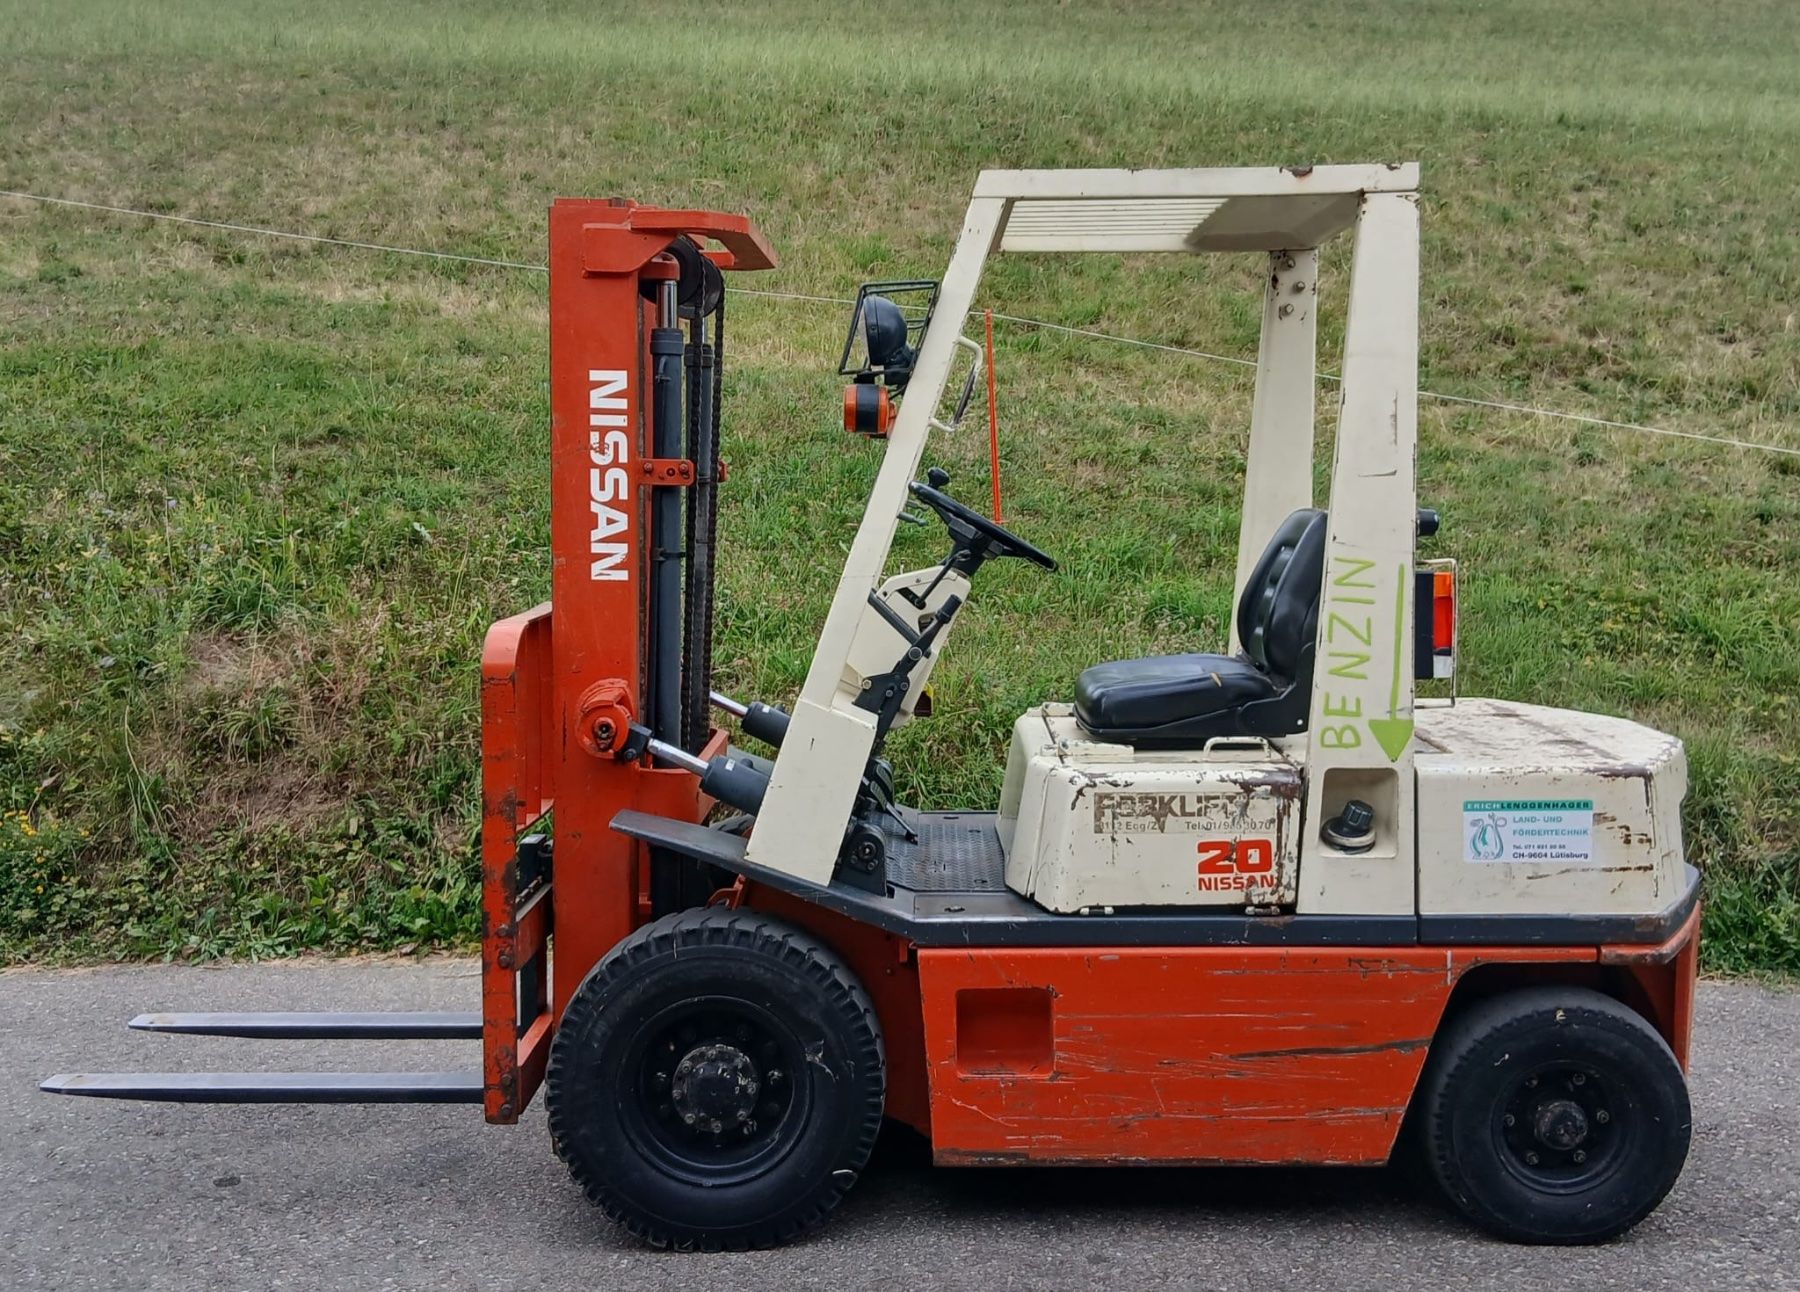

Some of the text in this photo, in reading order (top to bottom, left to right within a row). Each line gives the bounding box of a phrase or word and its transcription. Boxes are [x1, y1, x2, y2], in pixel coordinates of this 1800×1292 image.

[589, 369, 629, 581] NISSAN
[1320, 557, 1376, 749] BENZIN
[1097, 794, 1237, 818] FORKLIFT
[1467, 802, 1590, 810] ERICH LENGGENHAGER
[1512, 828, 1589, 836] FÖRDERTECHNIK
[1197, 840, 1272, 874] 20
[1550, 851, 1589, 860] Lütisburg
[1198, 875, 1275, 891] NISSAN
